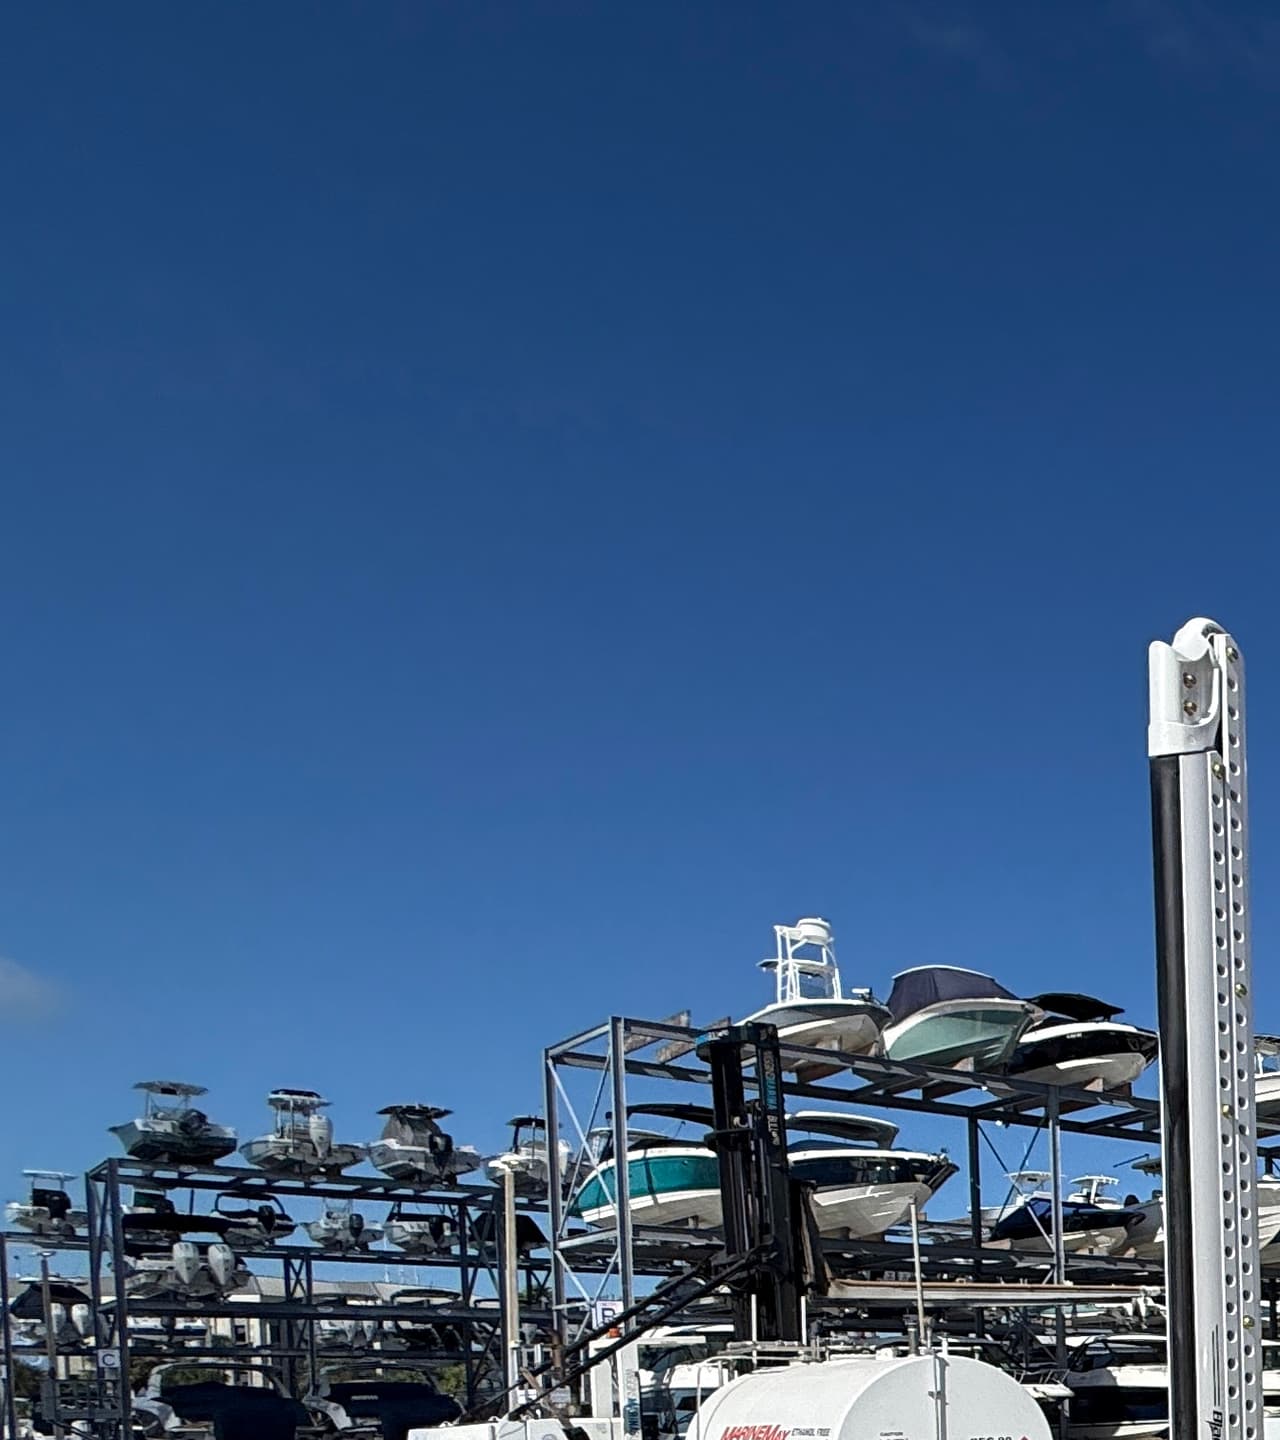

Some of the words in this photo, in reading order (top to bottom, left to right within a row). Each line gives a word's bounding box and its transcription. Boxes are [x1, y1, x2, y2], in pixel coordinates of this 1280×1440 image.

[102, 1353, 116, 1366] C
[791, 1428, 815, 1437] ETHANOL
[817, 1428, 831, 1436] FREE
